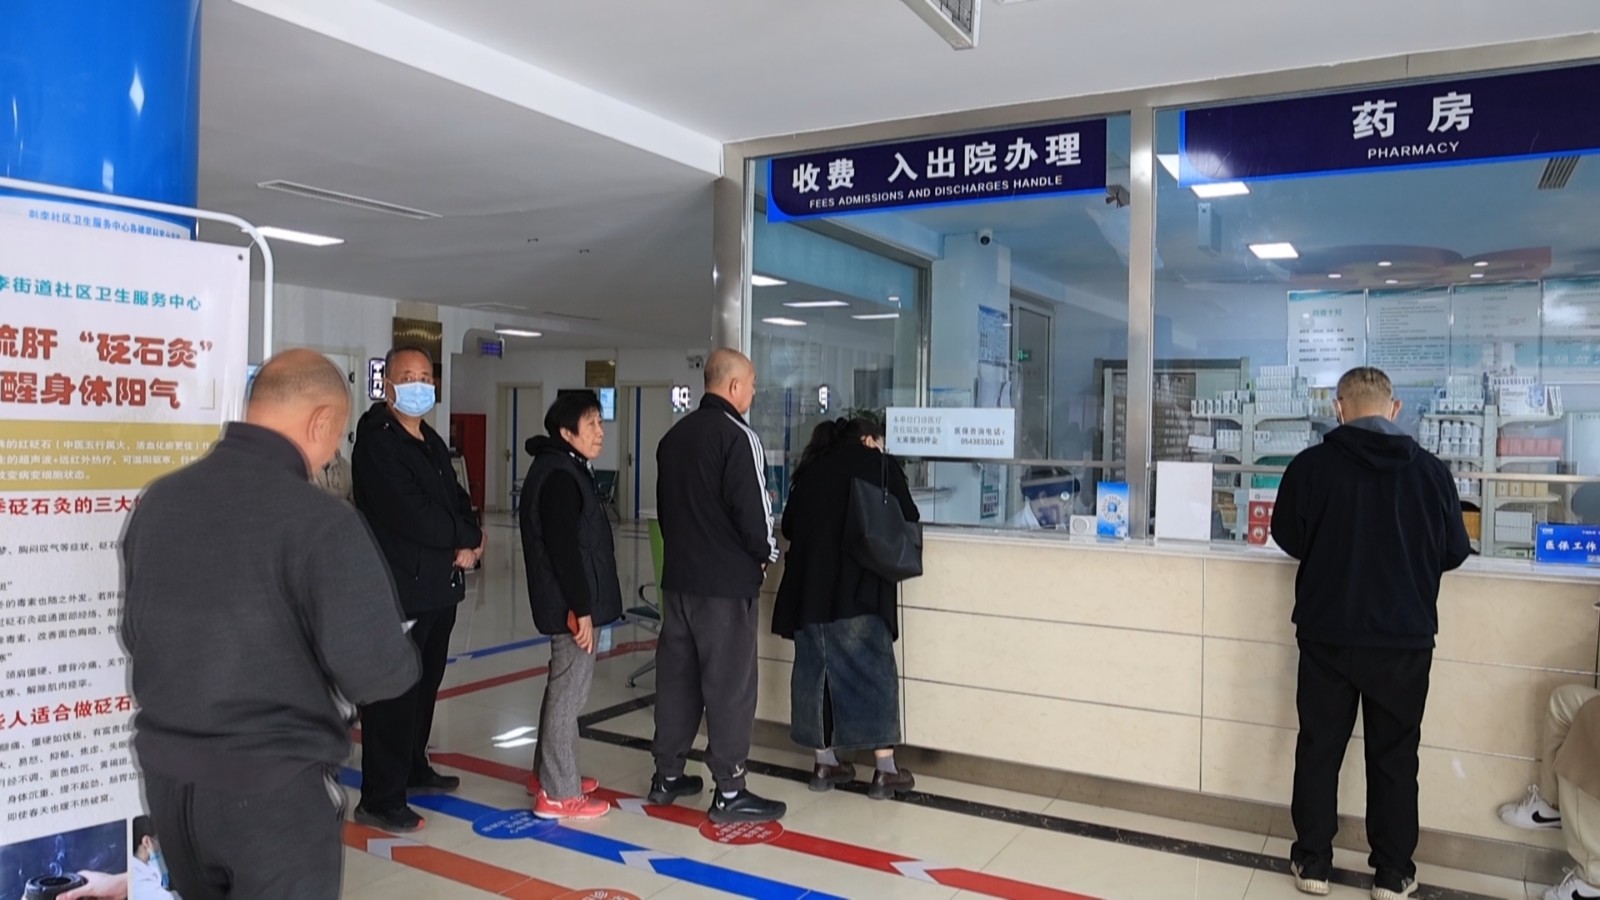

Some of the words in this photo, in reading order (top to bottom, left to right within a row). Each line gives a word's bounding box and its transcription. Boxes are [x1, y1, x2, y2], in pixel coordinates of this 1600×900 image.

[792, 158, 855, 193] 收费
[888, 132, 1081, 183] 入出院办理
[1368, 141, 1460, 159] PHARMACY
[809, 198, 835, 209] FEES
[838, 190, 904, 206] ADMISSIONS
[908, 187, 931, 198] AND
[935, 179, 1009, 197] DISCHARGES
[1013, 175, 1063, 189] HANDLE
[0, 371, 181, 409] 醒身体阳气
[0, 496, 141, 516] 砭石灸的三大
